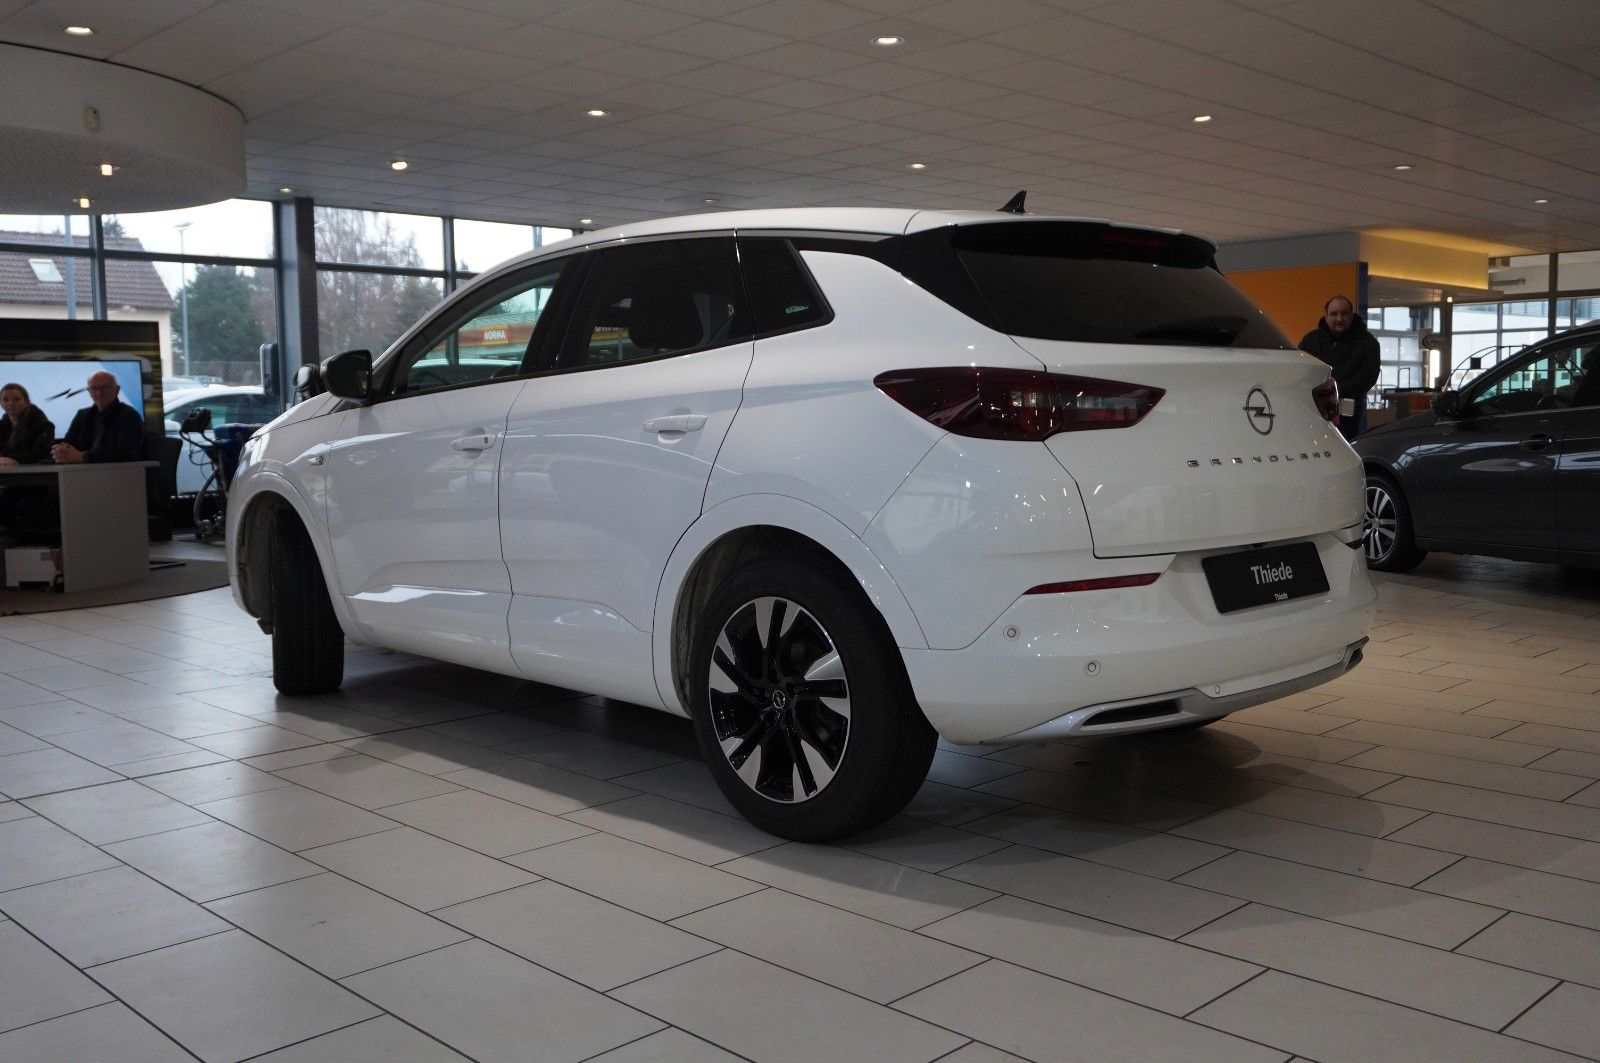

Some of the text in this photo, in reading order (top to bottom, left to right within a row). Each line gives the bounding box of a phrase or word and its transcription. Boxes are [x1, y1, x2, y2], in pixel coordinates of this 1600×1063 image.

[483, 329, 506, 340] NORMA
[1187, 451, 1331, 467] GRANDLAND
[1250, 561, 1293, 585] Thiede
[1274, 592, 1289, 601] Thiede
